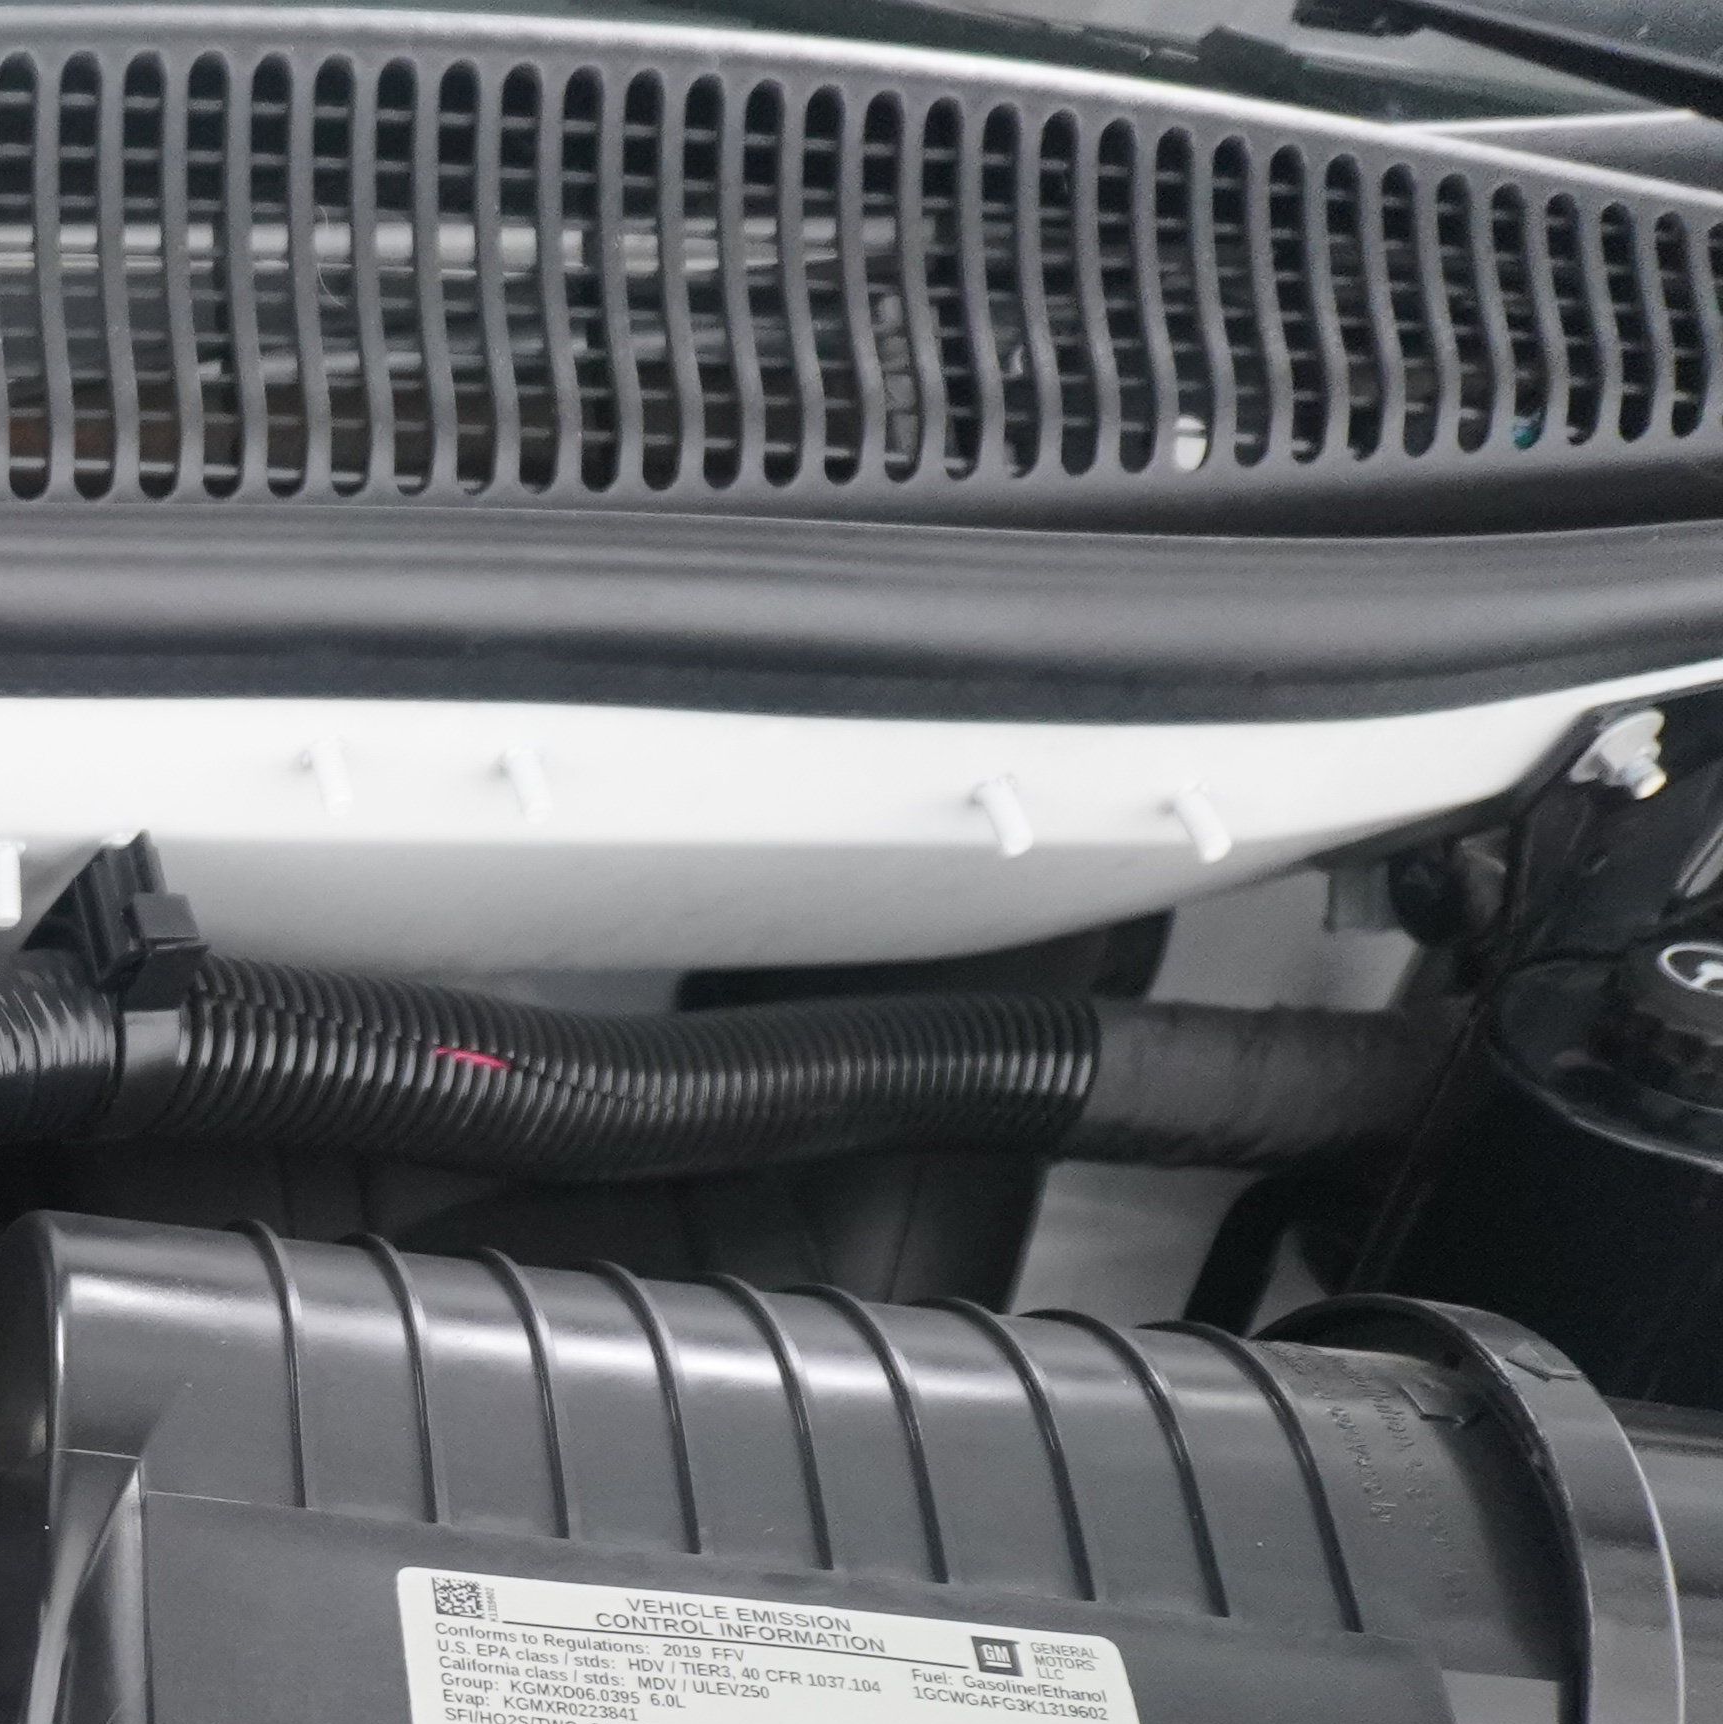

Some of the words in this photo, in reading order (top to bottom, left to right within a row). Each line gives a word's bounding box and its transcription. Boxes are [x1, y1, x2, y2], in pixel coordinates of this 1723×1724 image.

[626, 1598, 729, 1620] VEHICLE
[736, 1608, 852, 1632] EMISSION
[435, 1622, 517, 1643] Conforms
[522, 1633, 538, 1645] to
[543, 1633, 650, 1655] Regulations:
[662, 1643, 702, 1658] 2019
[712, 1647, 745, 1662] FFV
[596, 1613, 714, 1636] CONTROL
[719, 1622, 886, 1653] INFORMATION
[437, 1639, 471, 1656] U.S.
[476, 1643, 511, 1659] EPA
[515, 1648, 559, 1664] class
[573, 1655, 616, 1669] stds:
[628, 1658, 664, 1673] HDV
[679, 1662, 736, 1680] TIER3,
[741, 1667, 760, 1681] 40
[765, 1669, 803, 1685] CFR
[807, 1673, 882, 1694] 1037.104
[981, 1643, 1013, 1664] GM
[1030, 1642, 1100, 1660] GENERAL
[1034, 1655, 1096, 1672] MOTORS
[439, 1656, 520, 1677] California
[525, 1666, 568, 1682] class
[583, 1672, 625, 1687] stds:
[637, 1676, 676, 1692] MDV
[692, 1680, 770, 1699] ULEV250
[441, 1672, 499, 1693] Group:
[510, 1680, 640, 1705] KGMXD06.0395
[650, 1693, 686, 1709] 6.0L
[912, 1669, 954, 1686] Fuel:
[963, 1675, 1107, 1703] Gasoline/Ethanol
[1037, 1668, 1065, 1681] LLC
[443, 1689, 490, 1708] Evap:
[503, 1695, 638, 1722] KGMXR0223841
